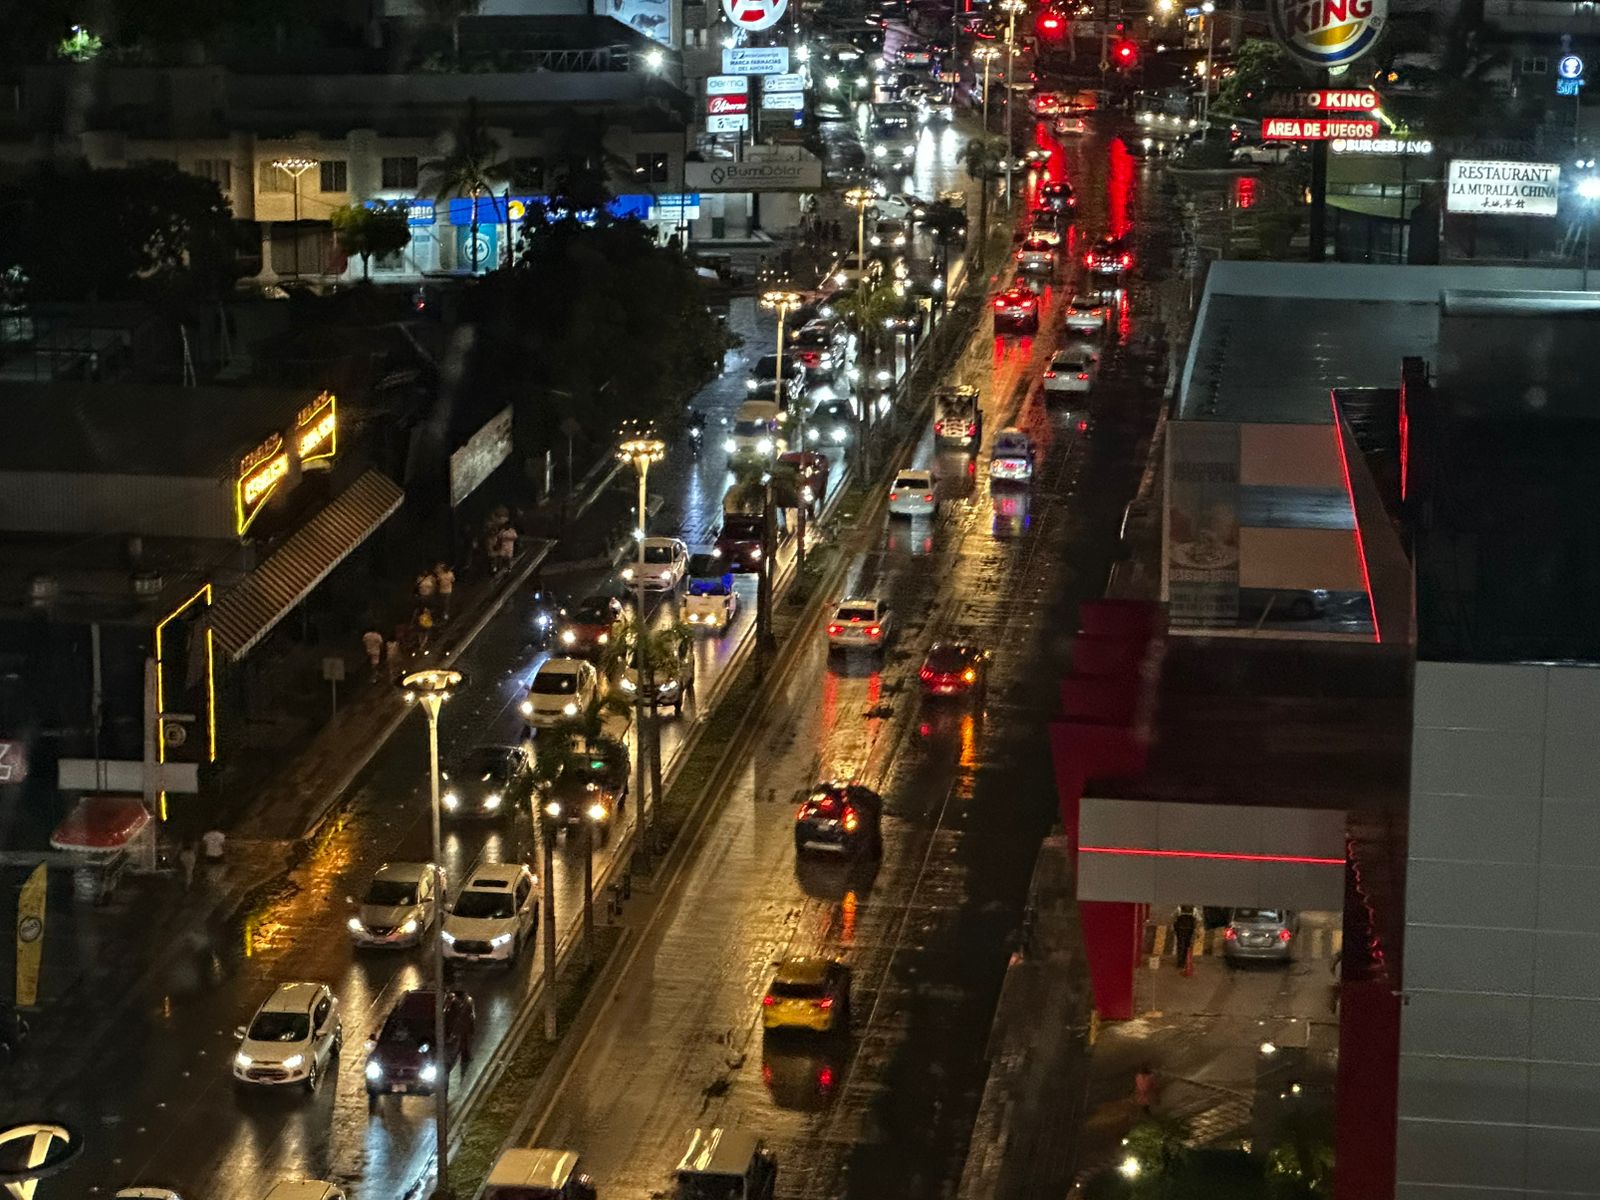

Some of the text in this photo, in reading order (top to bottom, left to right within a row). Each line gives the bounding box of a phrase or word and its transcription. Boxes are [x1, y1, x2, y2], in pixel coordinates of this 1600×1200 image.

[1285, 0, 1373, 39] KING
[1270, 93, 1376, 108] AUTO KING
[1303, 123, 1321, 137] DE
[1323, 123, 1373, 138] JUEGOS
[1346, 139, 1397, 152] BURGER
[1458, 166, 1551, 182] RESTAURANT
[1452, 183, 1556, 198] LA MURALLA CHINA
